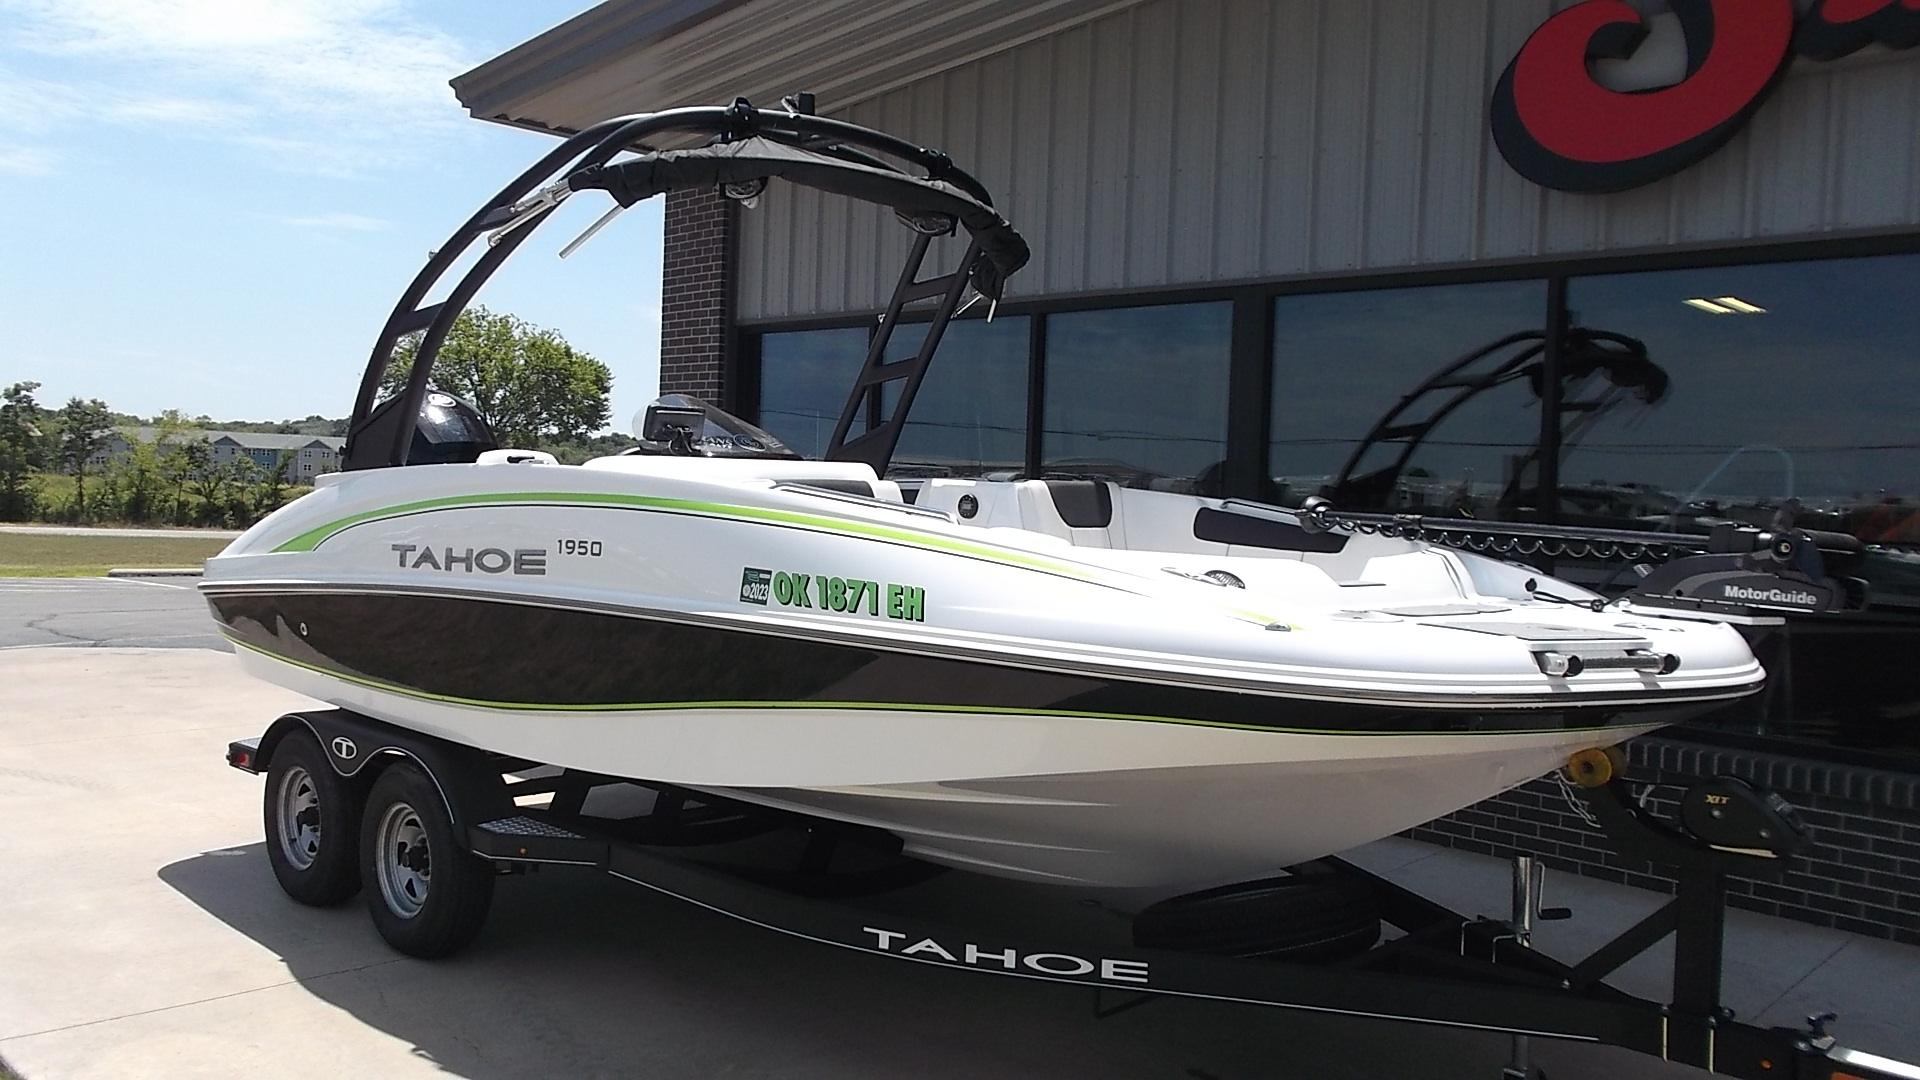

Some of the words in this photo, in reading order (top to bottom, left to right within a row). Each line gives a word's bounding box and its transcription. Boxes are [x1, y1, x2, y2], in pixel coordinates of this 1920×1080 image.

[391, 544, 547, 575] TAHOE
[557, 539, 603, 557] 1950
[749, 582, 769, 601] 2023
[773, 571, 813, 609] OK
[816, 575, 879, 616] 1871
[887, 583, 925, 622] EH
[1724, 585, 1817, 605] MotorGuide
[863, 926, 1148, 982] TAHOE
